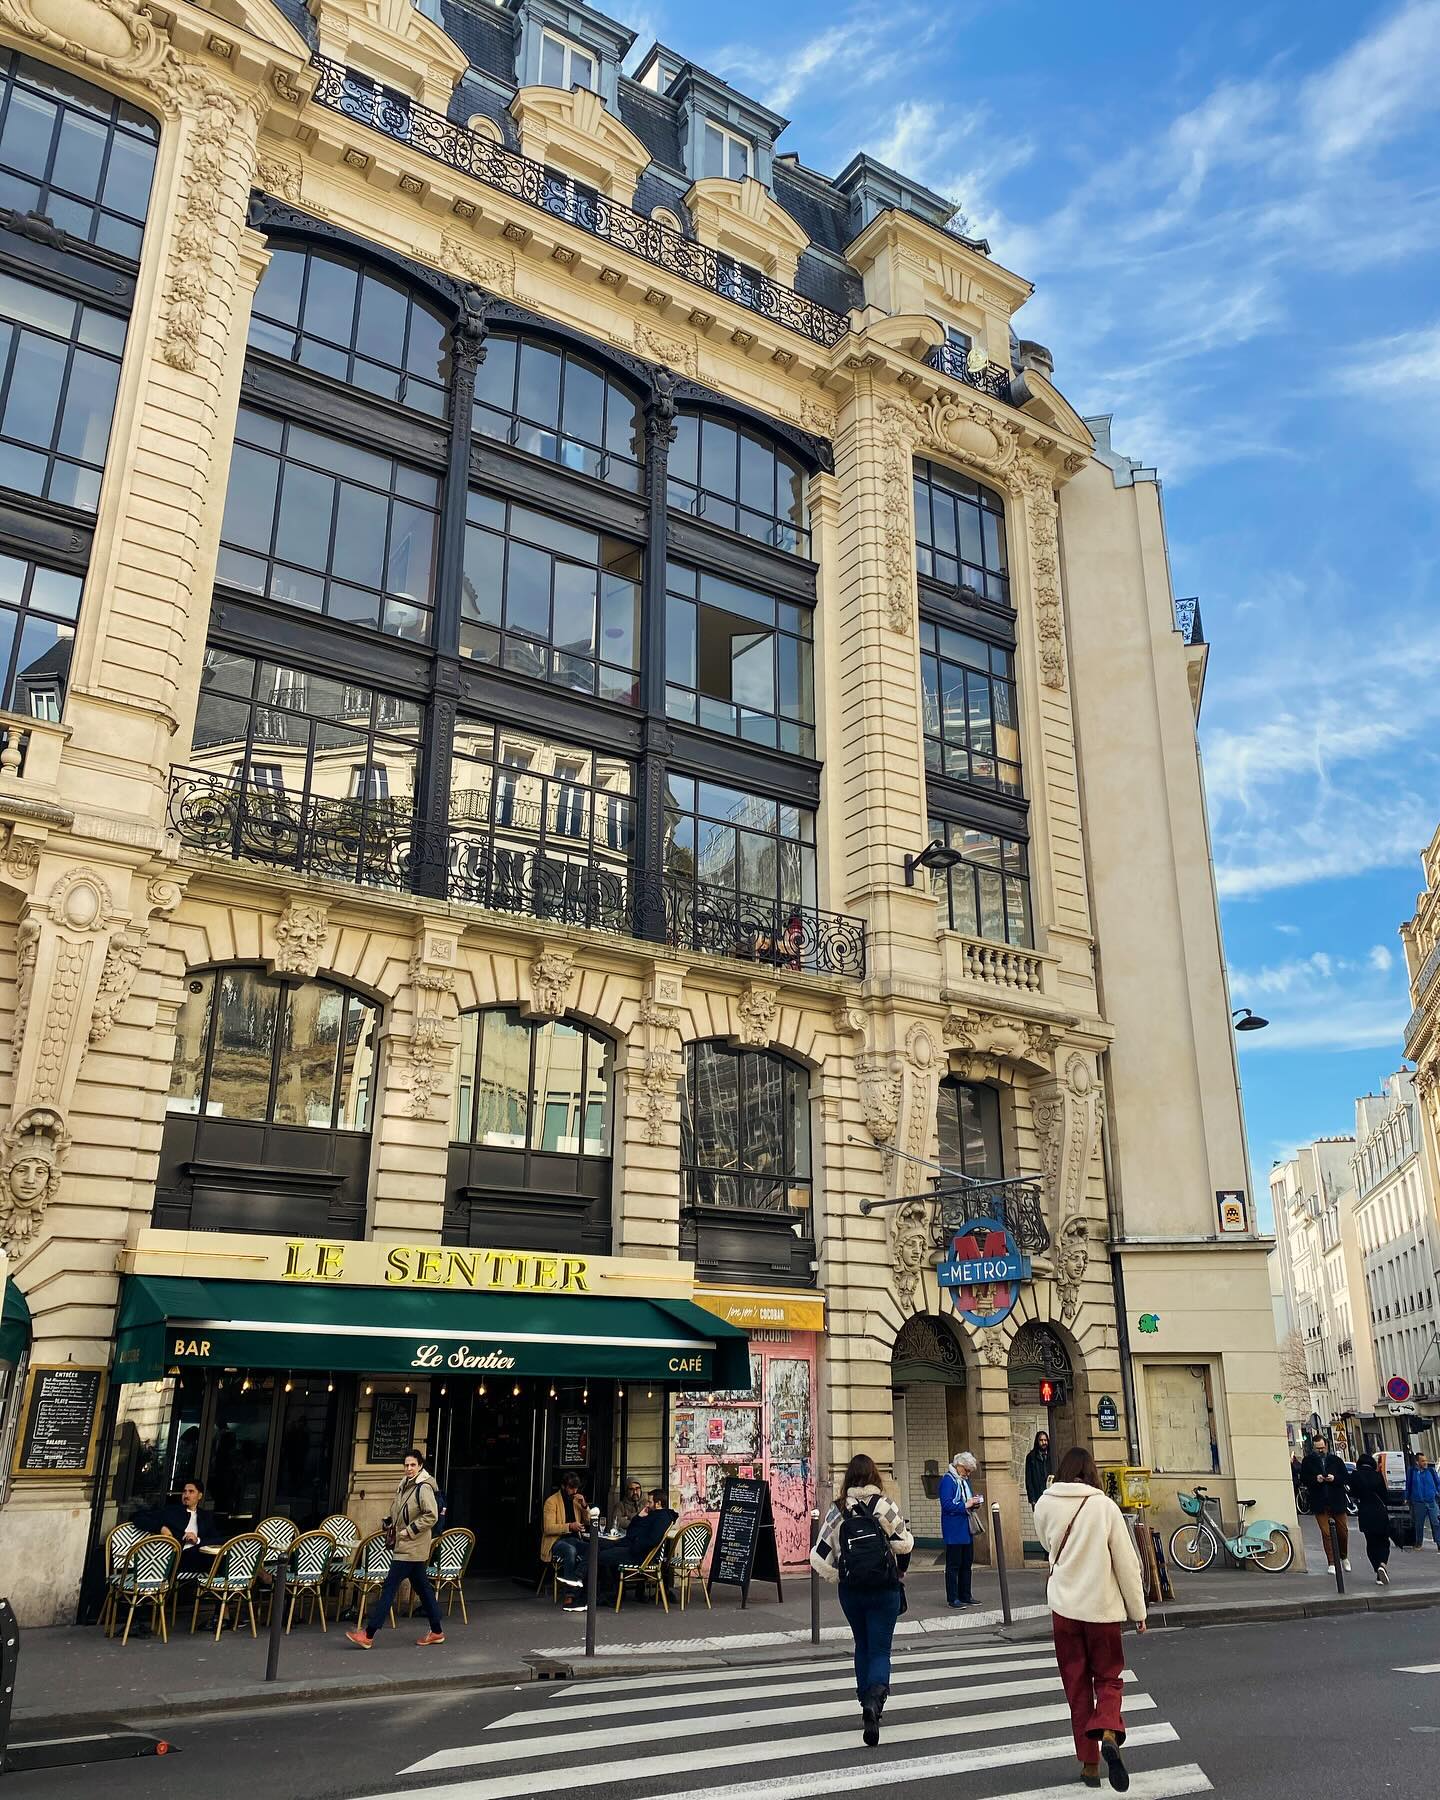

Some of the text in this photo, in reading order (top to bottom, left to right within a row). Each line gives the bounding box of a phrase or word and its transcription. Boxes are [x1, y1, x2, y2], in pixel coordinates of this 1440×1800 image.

[282, 1242, 592, 1291] LE SENTIER
[174, 1339, 211, 1357] BAR
[410, 1344, 516, 1370] Le Sentier
[668, 1355, 703, 1372] CAFÉ
